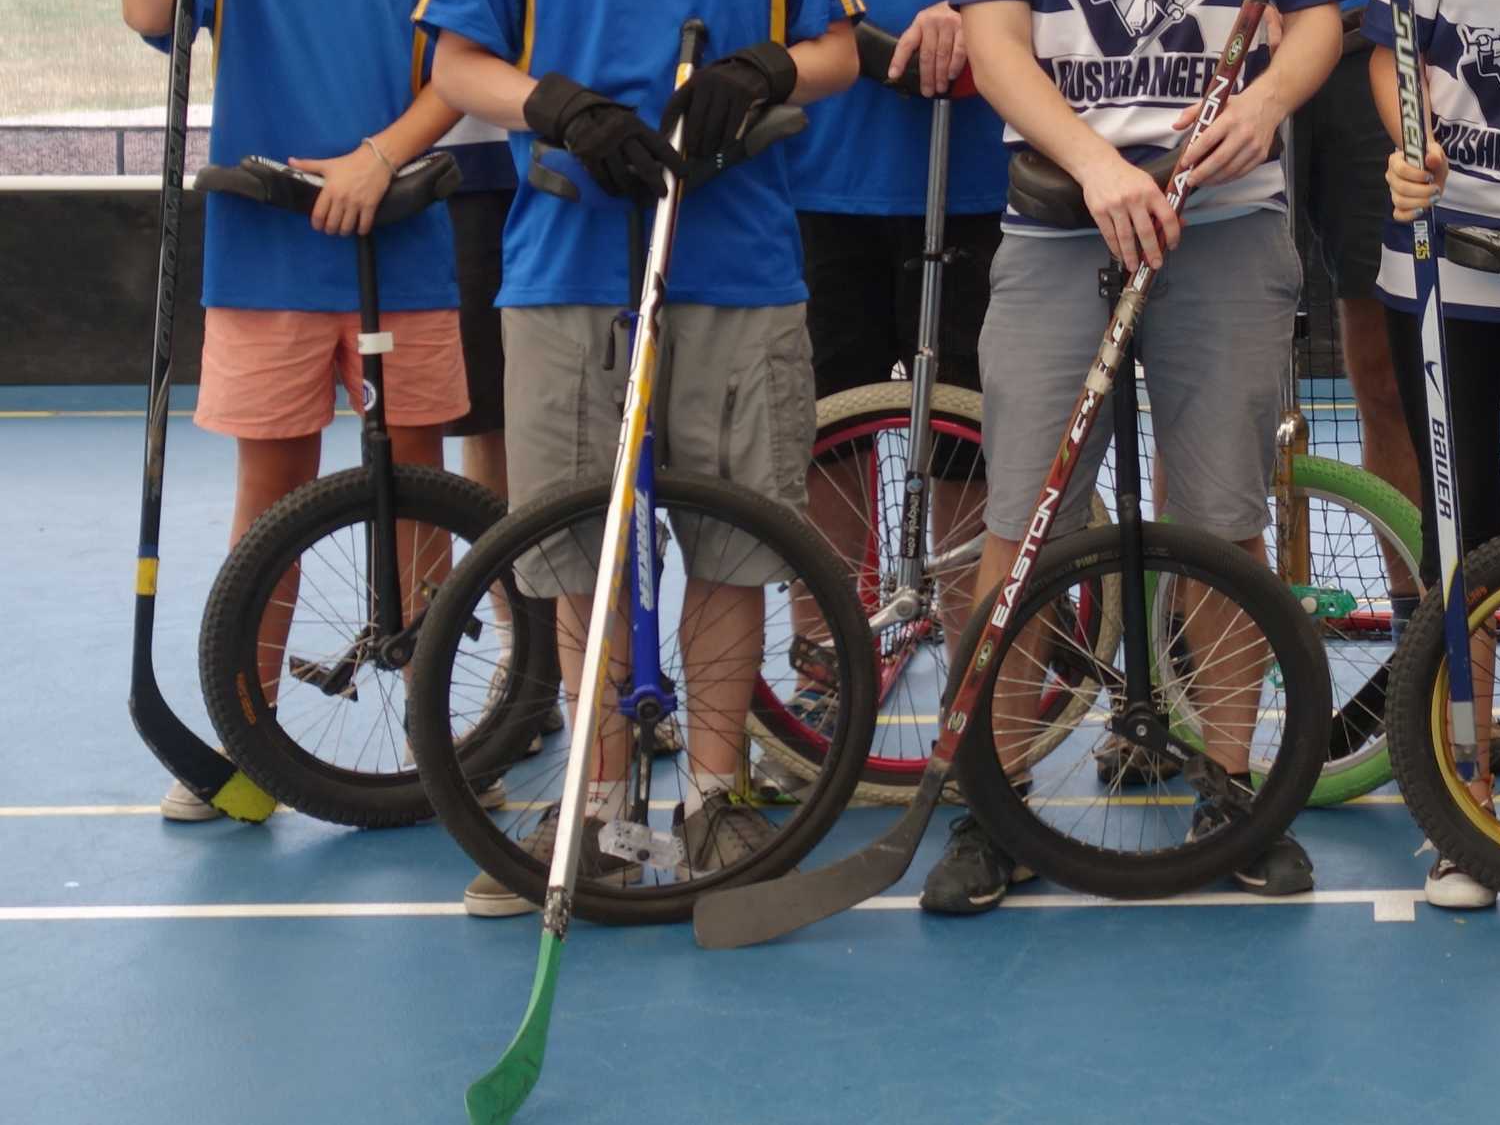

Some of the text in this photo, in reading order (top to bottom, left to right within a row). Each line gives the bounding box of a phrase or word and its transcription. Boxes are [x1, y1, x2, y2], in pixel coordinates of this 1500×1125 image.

[1167, 75, 1229, 210] EATON
[1431, 416, 1452, 521] BAUER
[991, 486, 1060, 629] EASTON
